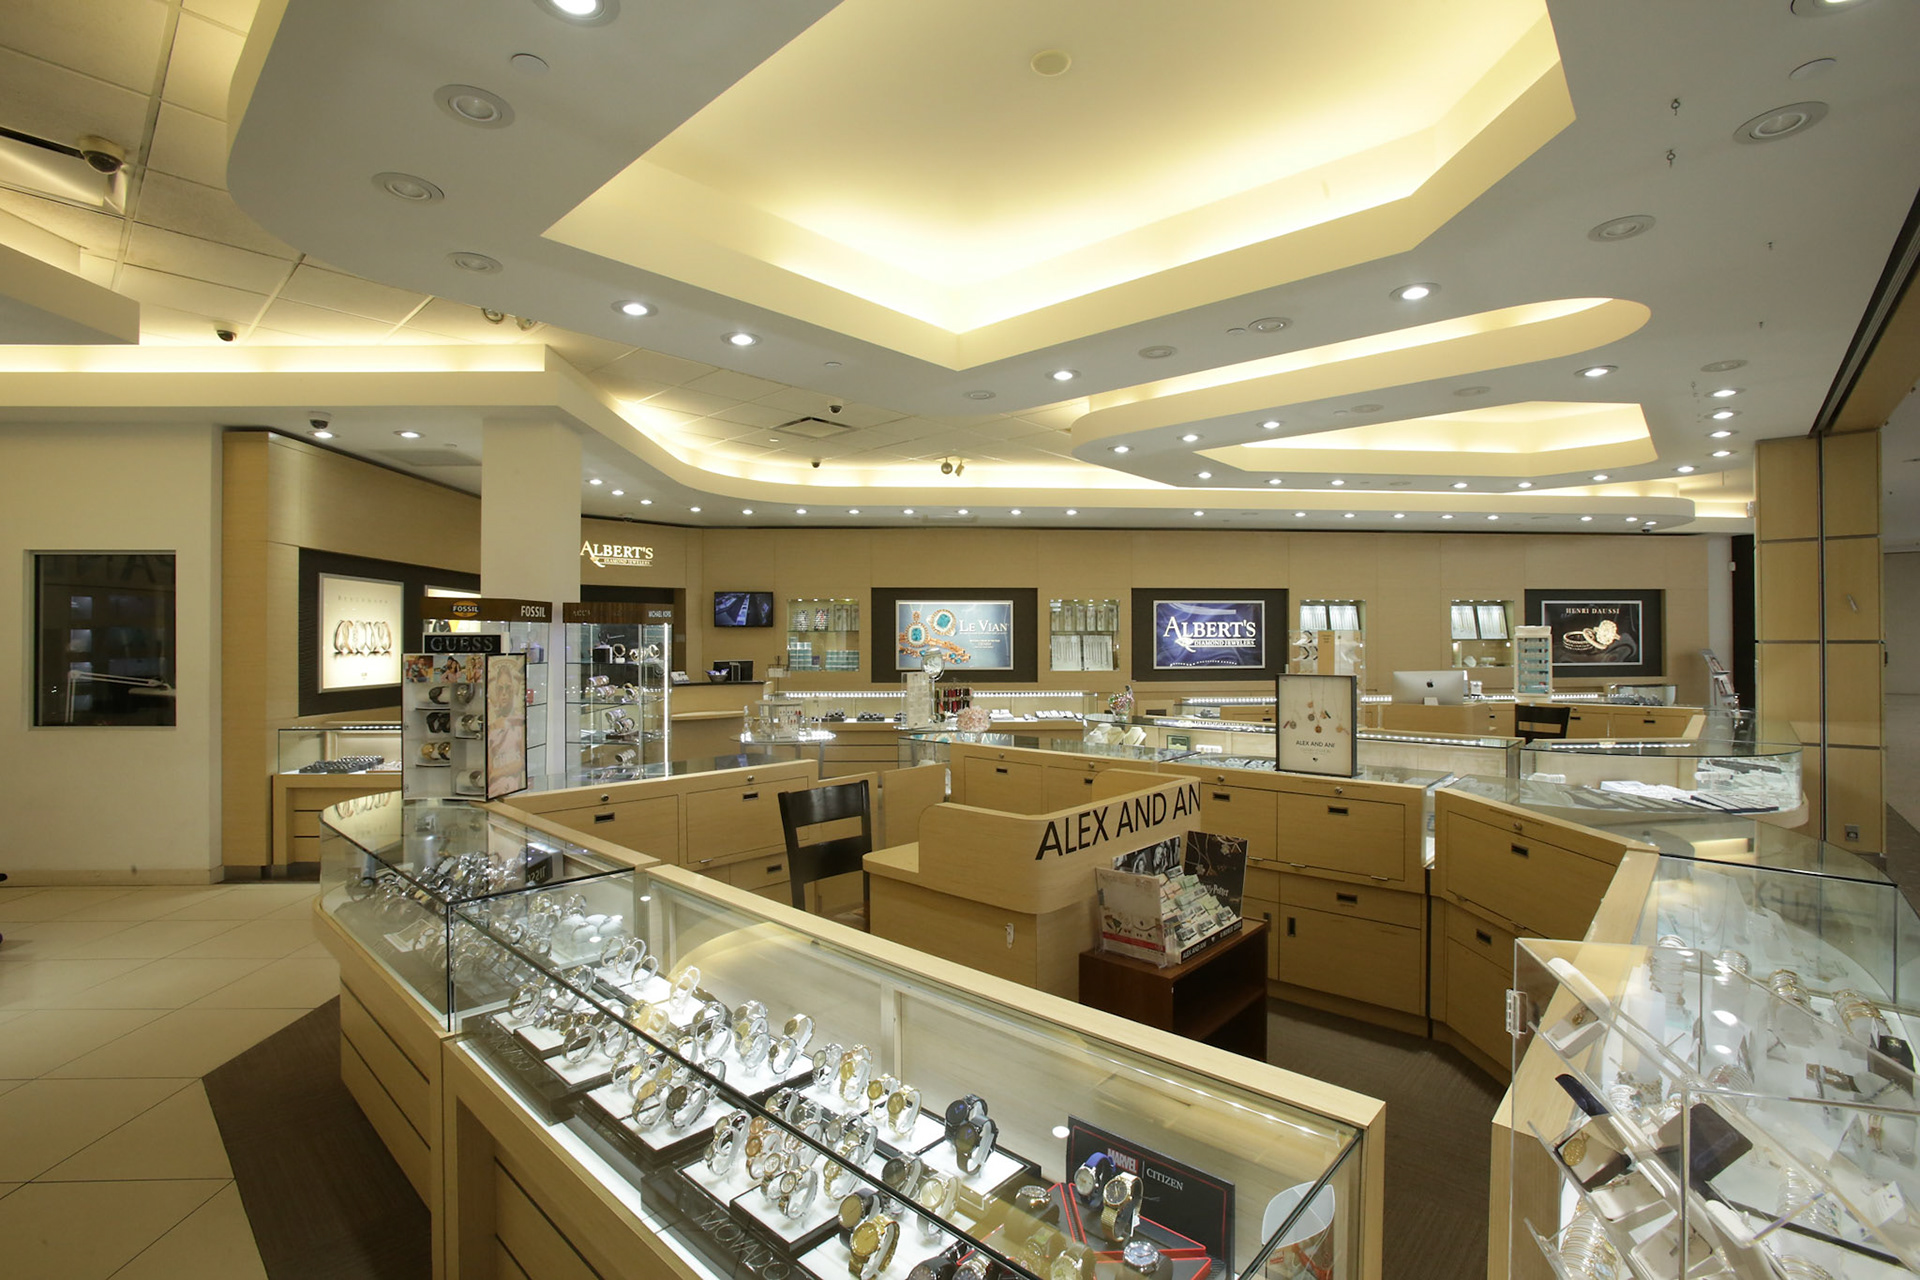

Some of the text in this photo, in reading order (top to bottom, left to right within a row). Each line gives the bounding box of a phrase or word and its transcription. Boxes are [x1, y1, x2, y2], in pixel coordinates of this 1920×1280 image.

[580, 540, 654, 561] ALBERT'S
[452, 605, 479, 613] FOSSIL
[521, 605, 546, 618] FOSSIL
[959, 619, 1008, 632] LE VIAN
[1163, 616, 1256, 638] ALBERT'S
[430, 636, 493, 652] GUESS
[1035, 806, 1109, 861] ALEX
[1116, 792, 1167, 838] AND
[1107, 1147, 1184, 1191] MARVEL CITIZEN
[692, 1209, 790, 1280] MOVADO
